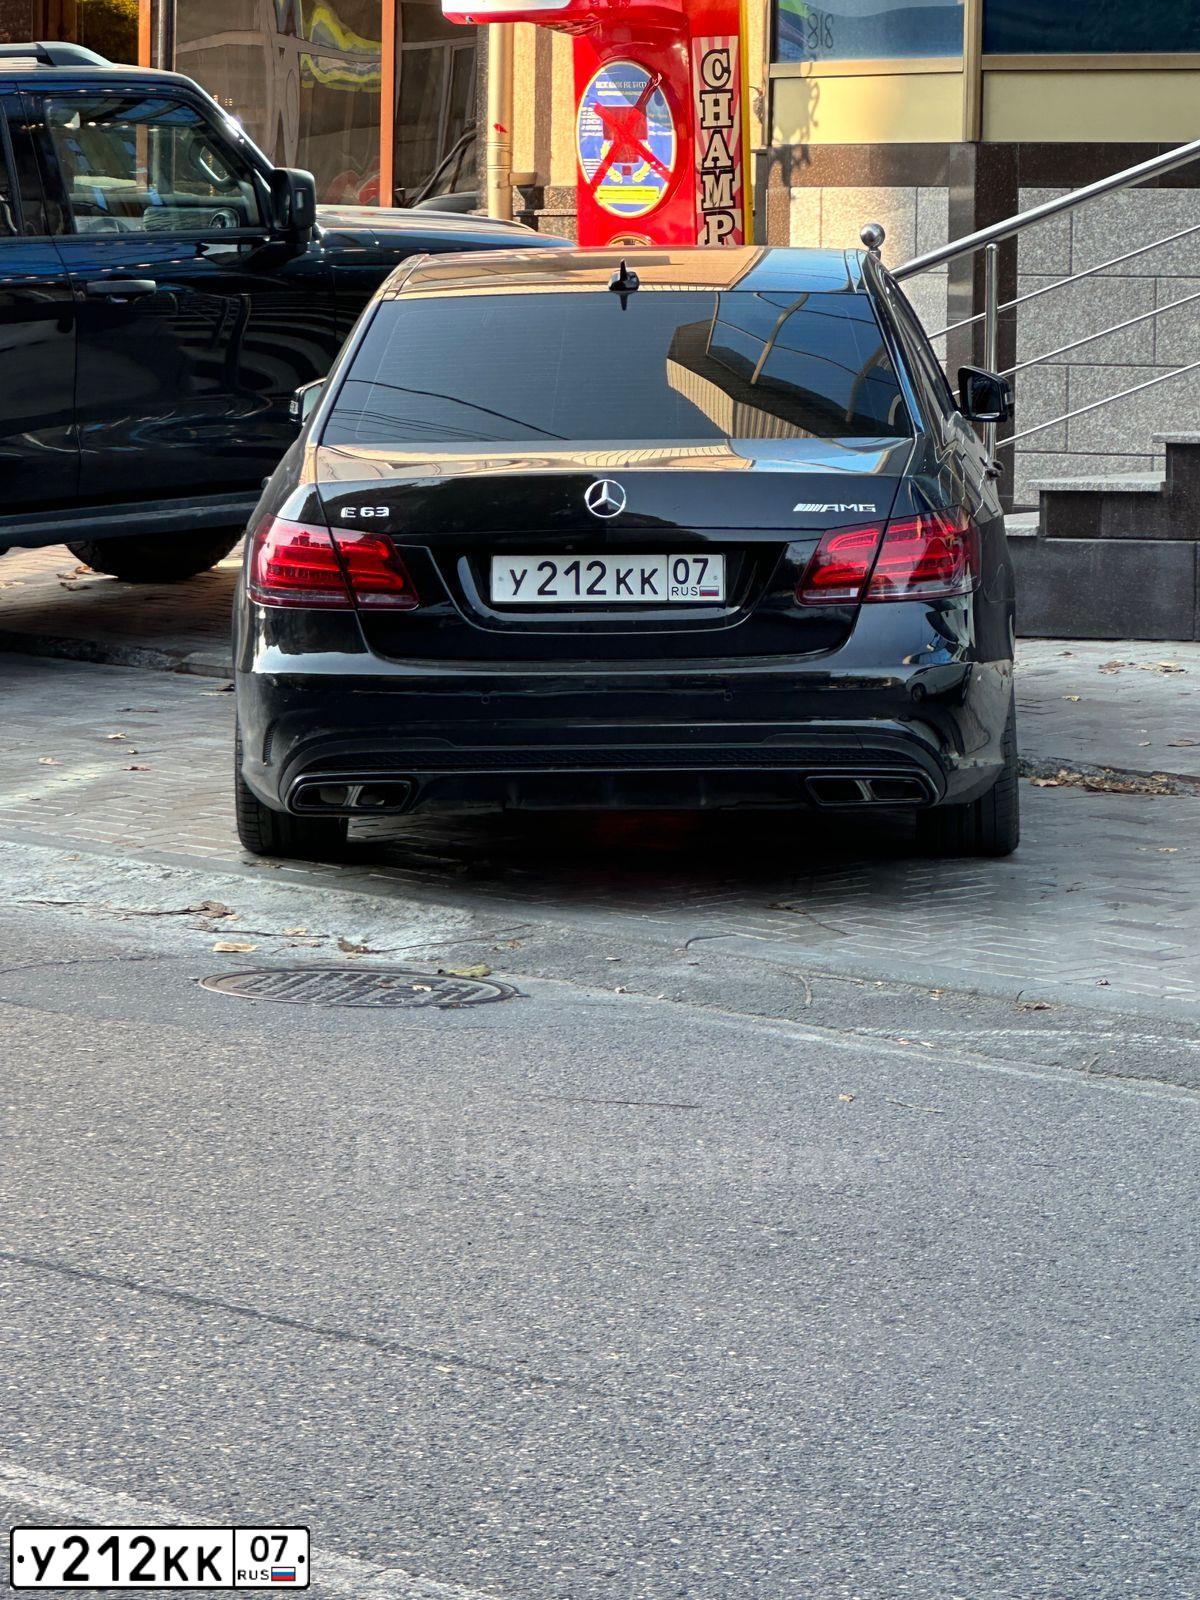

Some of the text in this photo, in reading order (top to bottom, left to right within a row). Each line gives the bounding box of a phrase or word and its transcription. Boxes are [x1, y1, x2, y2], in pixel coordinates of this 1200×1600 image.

[340, 506, 390, 519] E 63
[819, 503, 876, 513] AMG
[672, 558, 709, 585] 07
[671, 586, 699, 597] RUS
